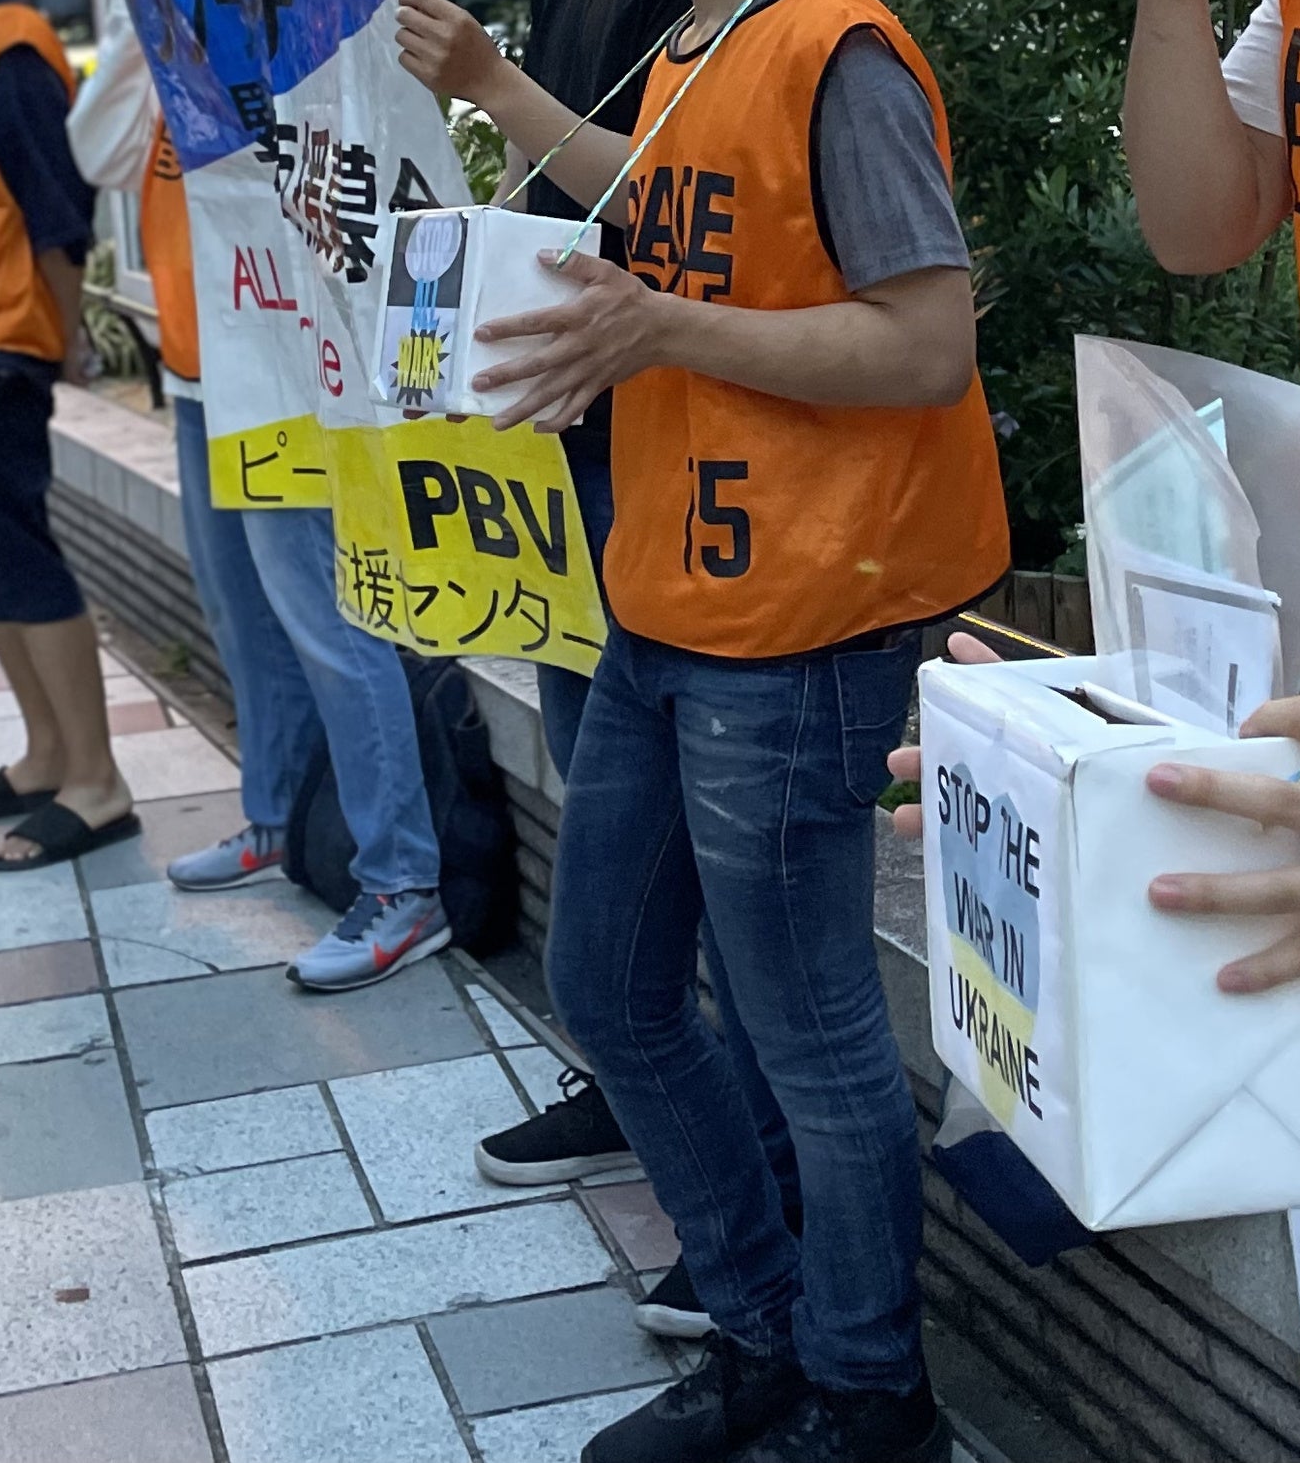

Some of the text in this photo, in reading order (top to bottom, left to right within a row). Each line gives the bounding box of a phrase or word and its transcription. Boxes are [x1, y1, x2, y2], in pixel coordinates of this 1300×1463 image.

[233, 244, 298, 310] ALL
[397, 335, 443, 389] WARS
[397, 459, 568, 577] PBV
[937, 764, 1041, 900] STOP THE
[953, 870, 1026, 999] WAR IN
[948, 965, 1045, 1122] UKRAINE
